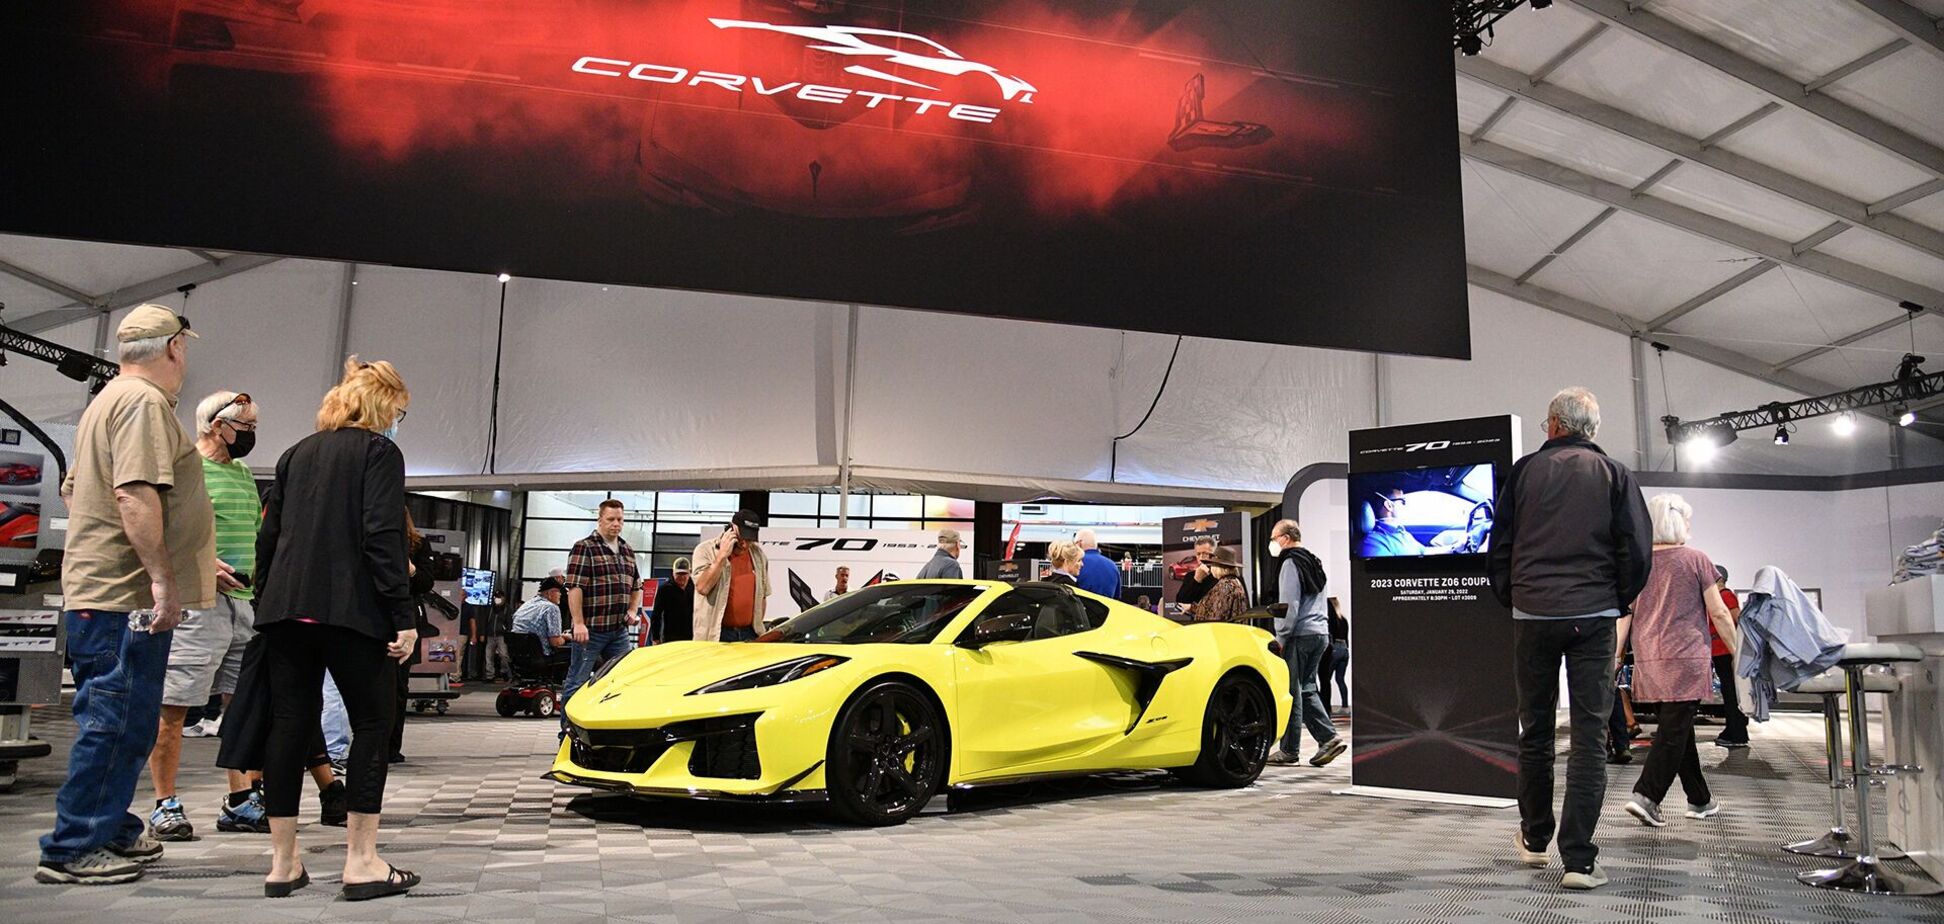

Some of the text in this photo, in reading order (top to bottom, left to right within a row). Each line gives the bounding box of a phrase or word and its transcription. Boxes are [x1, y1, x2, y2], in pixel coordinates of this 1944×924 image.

[571, 55, 1001, 124] CORVETTE
[1405, 440, 1451, 452] 70
[795, 537, 878, 551] 70
[1370, 579, 1392, 588] 2023
[1394, 577, 1439, 587] CORVETTE
[1441, 577, 1459, 587] Z06
